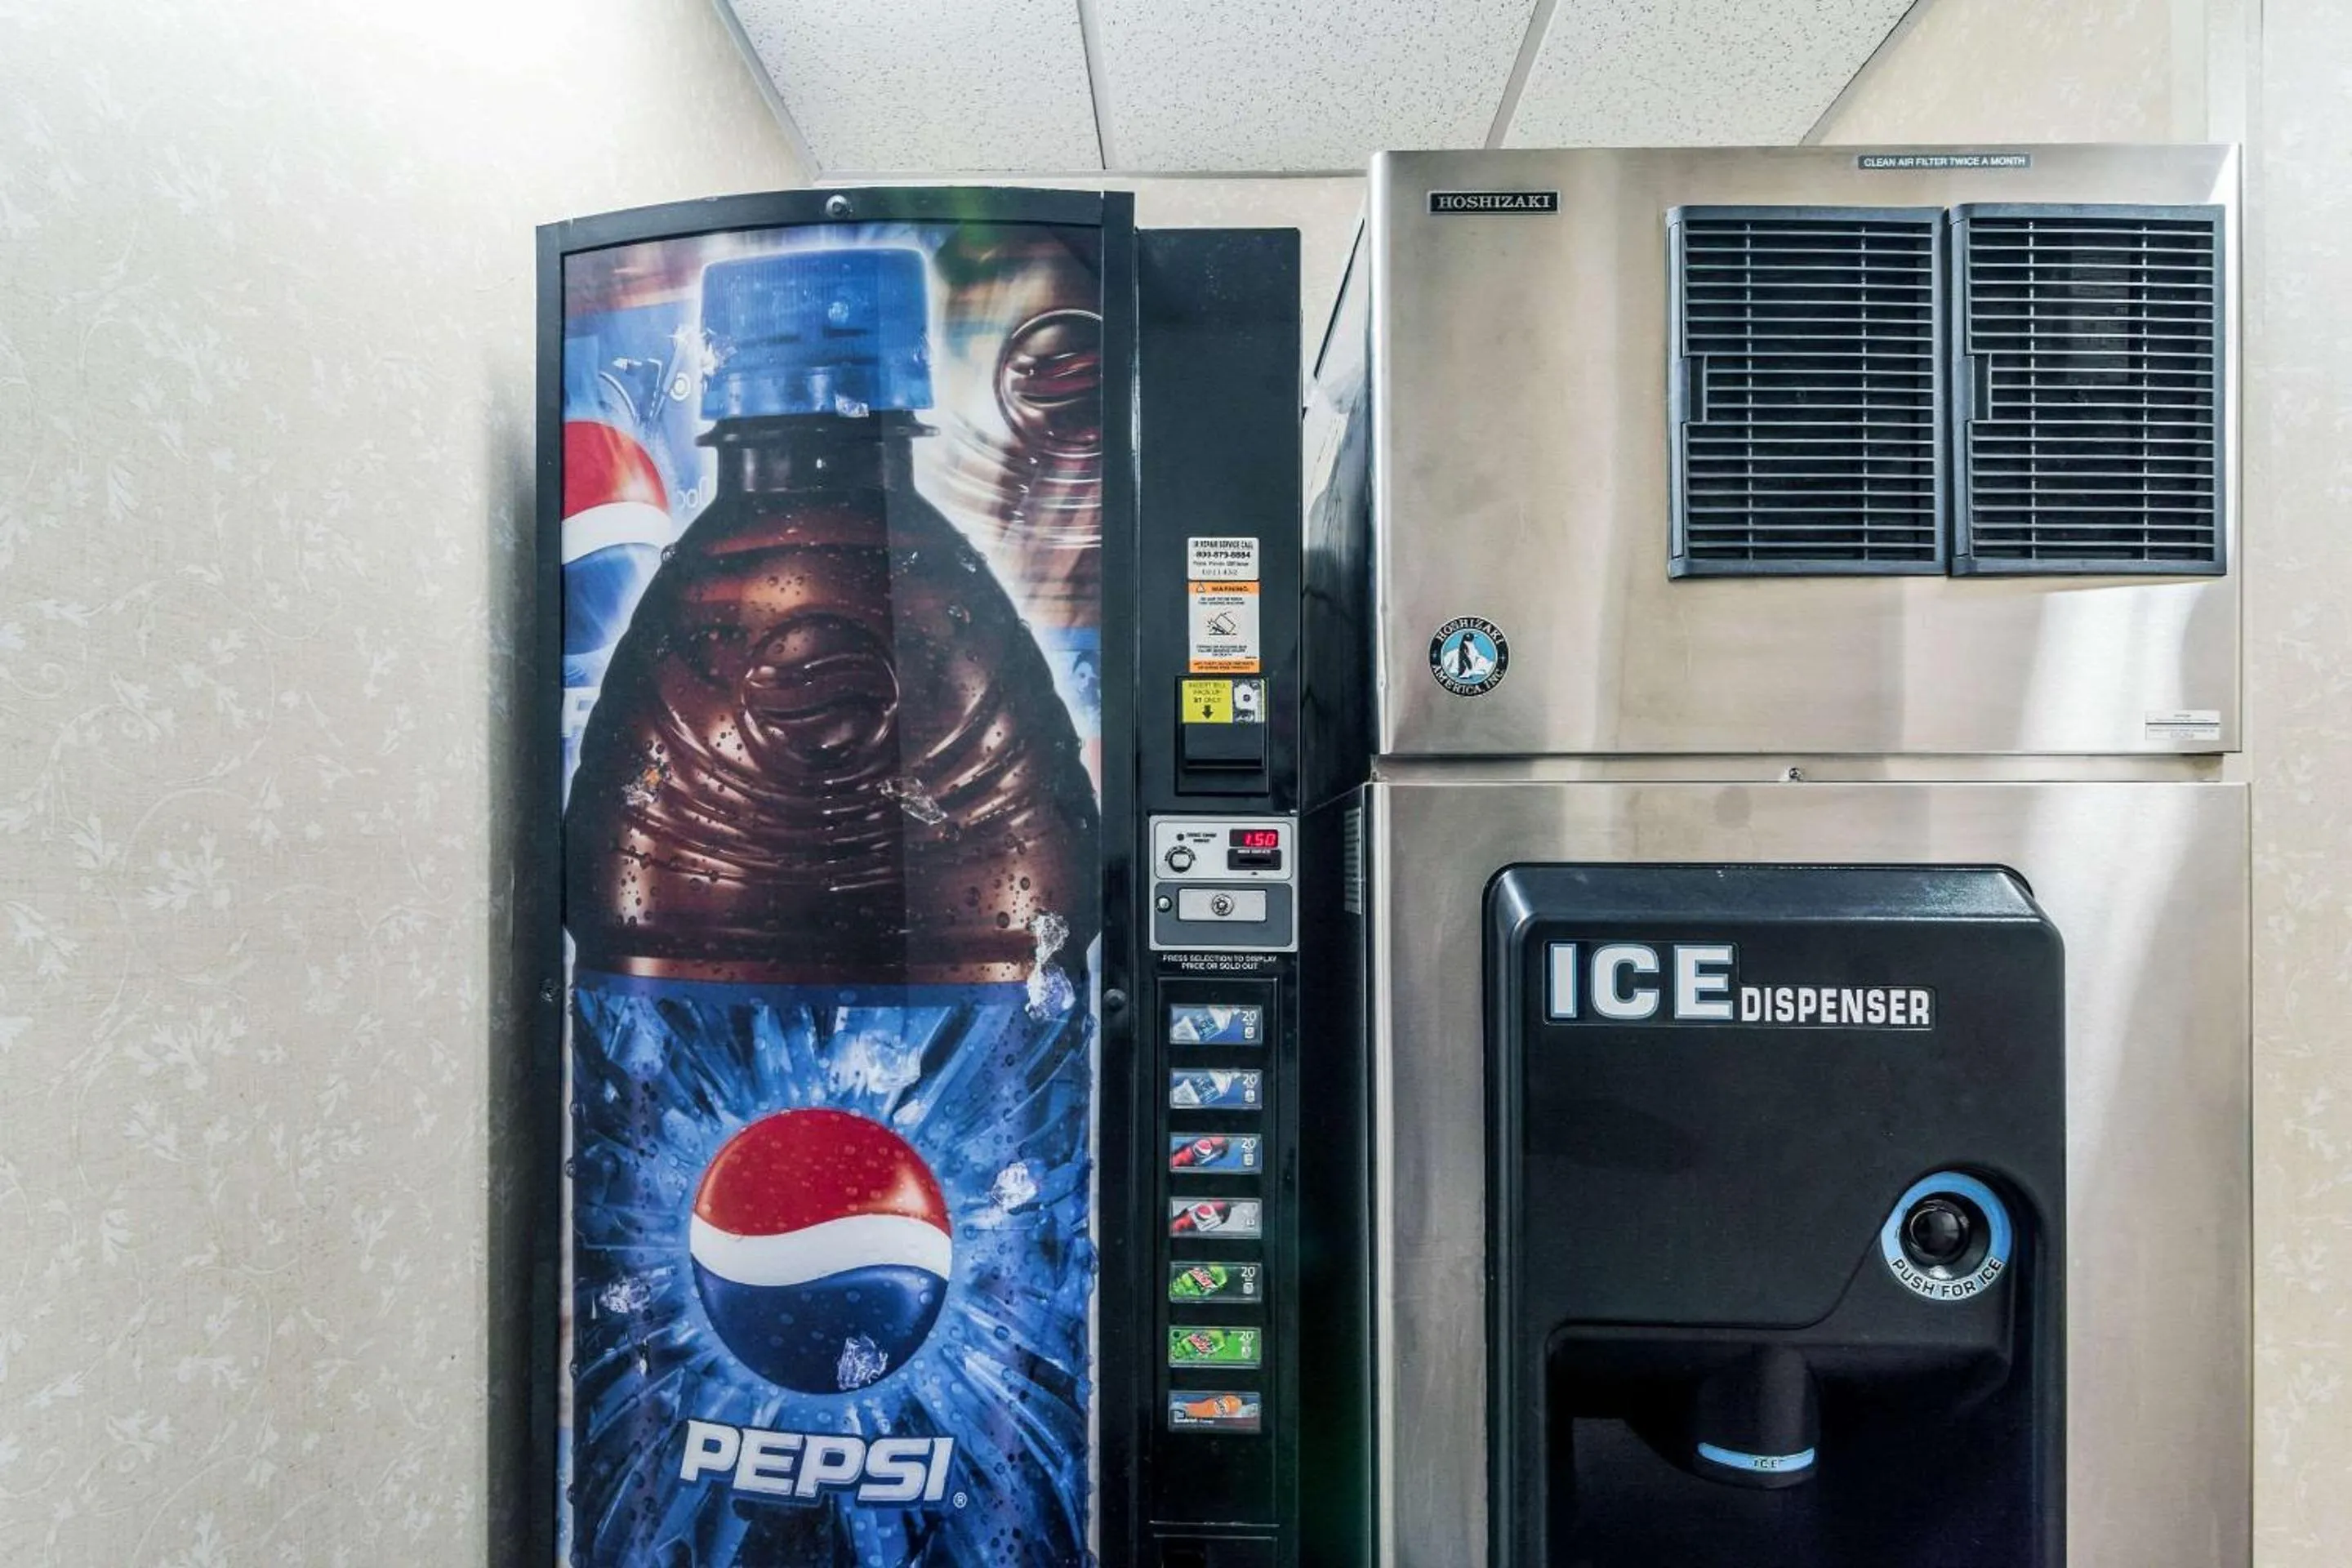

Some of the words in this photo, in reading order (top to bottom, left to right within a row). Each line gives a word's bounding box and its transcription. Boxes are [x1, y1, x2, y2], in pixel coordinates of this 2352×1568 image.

[1864, 158, 1896, 167] CLEAN
[1898, 158, 1913, 167] AIR
[1915, 158, 1947, 167] FILTER
[1949, 157, 1980, 166] TWICE
[1981, 158, 1989, 166] A
[1990, 156, 2025, 166] MONTH
[1437, 195, 1552, 208] HOSHIZAKI
[1436, 619, 1504, 644] HOSHIZAKI
[1245, 832, 1276, 846] 1.50
[1550, 942, 1734, 1020] ICE
[1741, 987, 1931, 1025] DISPENSER
[1241, 1010, 1258, 1022] 20
[1242, 1073, 1258, 1085] 20
[1241, 1138, 1257, 1149] 20
[1241, 1267, 1255, 1277] 20
[1891, 1258, 1936, 1295] PUSH
[1940, 1281, 1976, 1298] FOR
[1977, 1258, 2003, 1285] ICE
[679, 1419, 955, 1503] PEPSI
[1753, 1459, 1779, 1468] ICE
